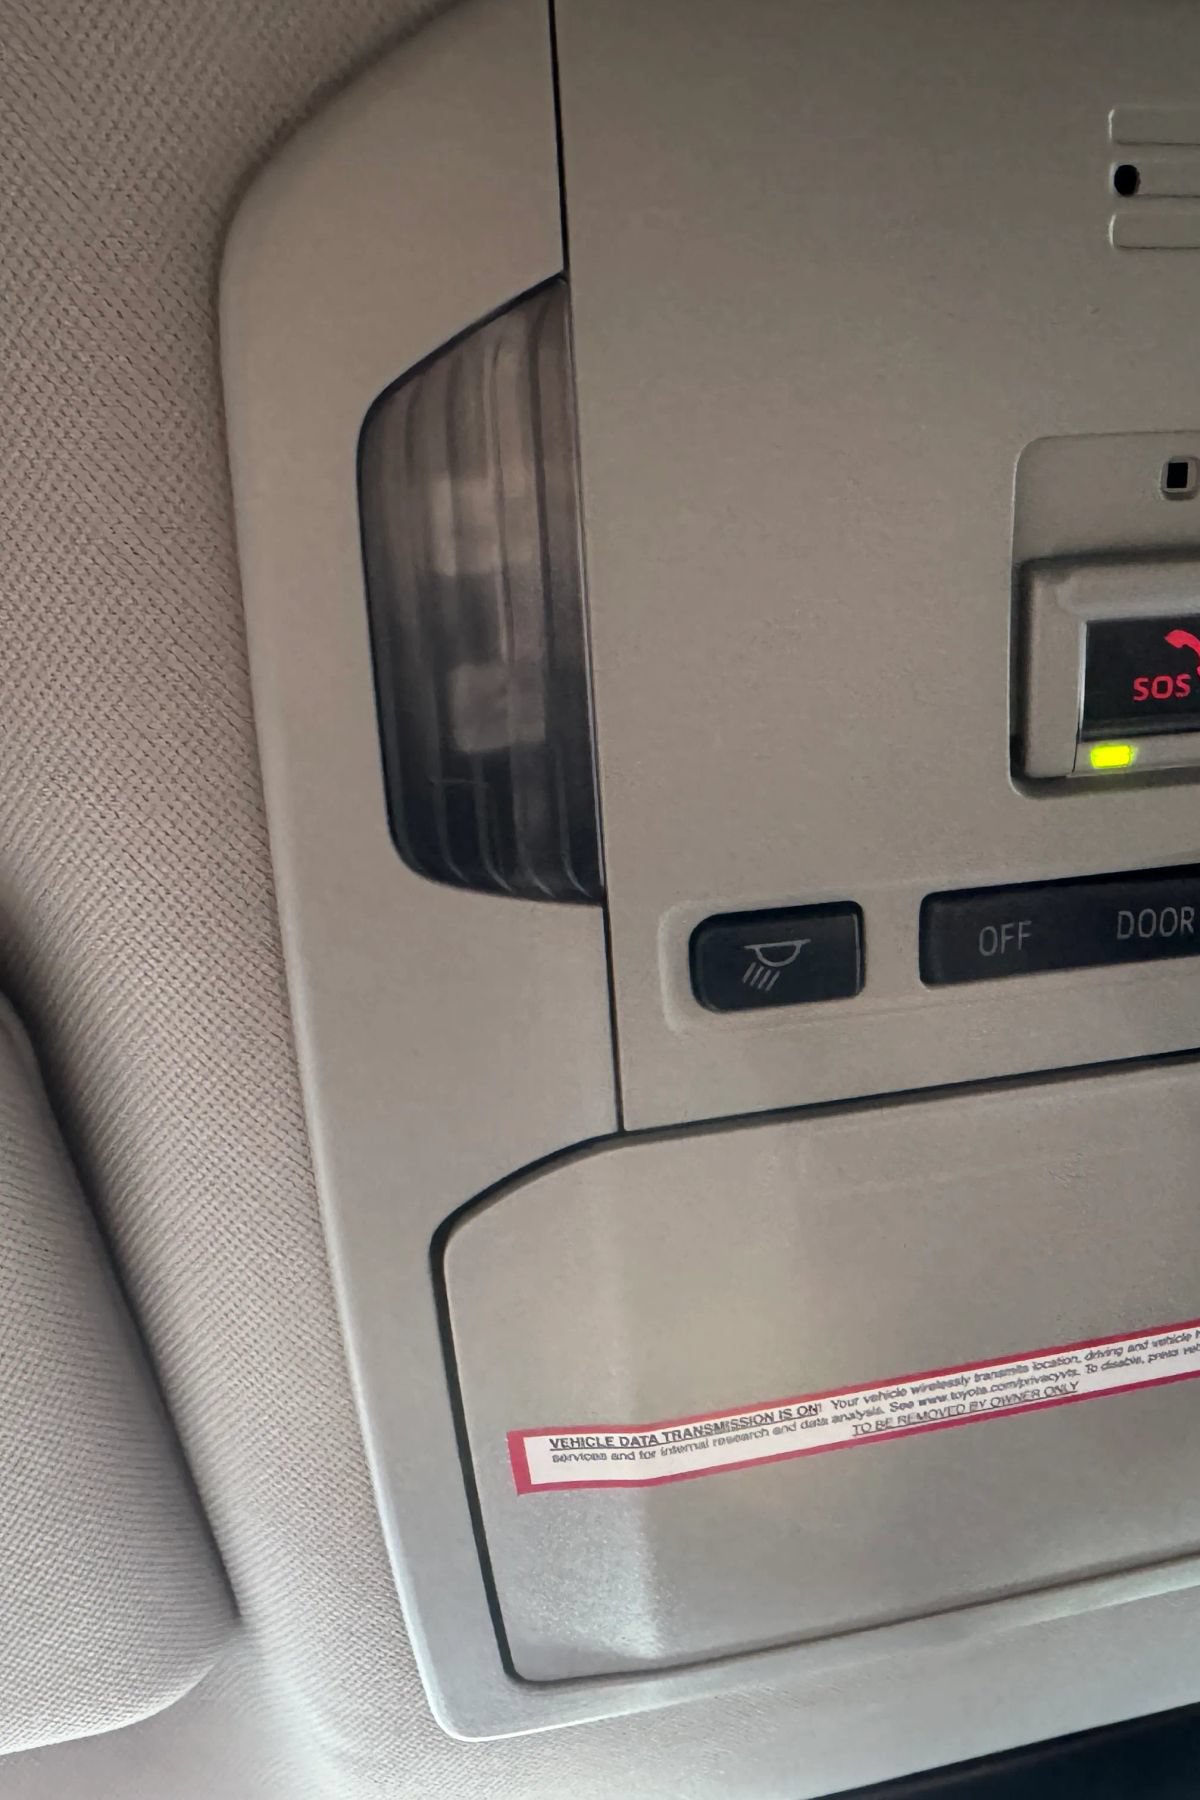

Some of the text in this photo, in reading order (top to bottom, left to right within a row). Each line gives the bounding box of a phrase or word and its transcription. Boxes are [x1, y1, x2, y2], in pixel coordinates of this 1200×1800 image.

[1132, 673, 1192, 702] SOS
[977, 920, 1033, 957] OFF
[1116, 906, 1196, 940] DOOR
[550, 1436, 615, 1450] VEHICLE
[619, 1434, 659, 1448] DATA
[662, 1410, 775, 1444] TRANSMISSION
[779, 1407, 793, 1420] IS
[830, 1396, 860, 1410] Your
[863, 1385, 908, 1404] vehicle
[911, 1375, 971, 1396] wirelessly
[974, 1364, 1030, 1383] transmits
[1084, 1344, 1124, 1362] driving
[1127, 1339, 1149, 1353] and
[1152, 1331, 1192, 1349] vehicle
[552, 1451, 607, 1463] services
[611, 1450, 636, 1461] and
[639, 1449, 657, 1460] for
[660, 1439, 710, 1457] internal
[712, 1428, 770, 1447] research
[772, 1421, 798, 1436] and
[800, 1416, 829, 1430] data
[889, 1401, 915, 1413] See
[1148, 1349, 1180, 1364] press
[852, 1381, 1079, 1437] TO BE REMOVED BY OWNER ONLY
